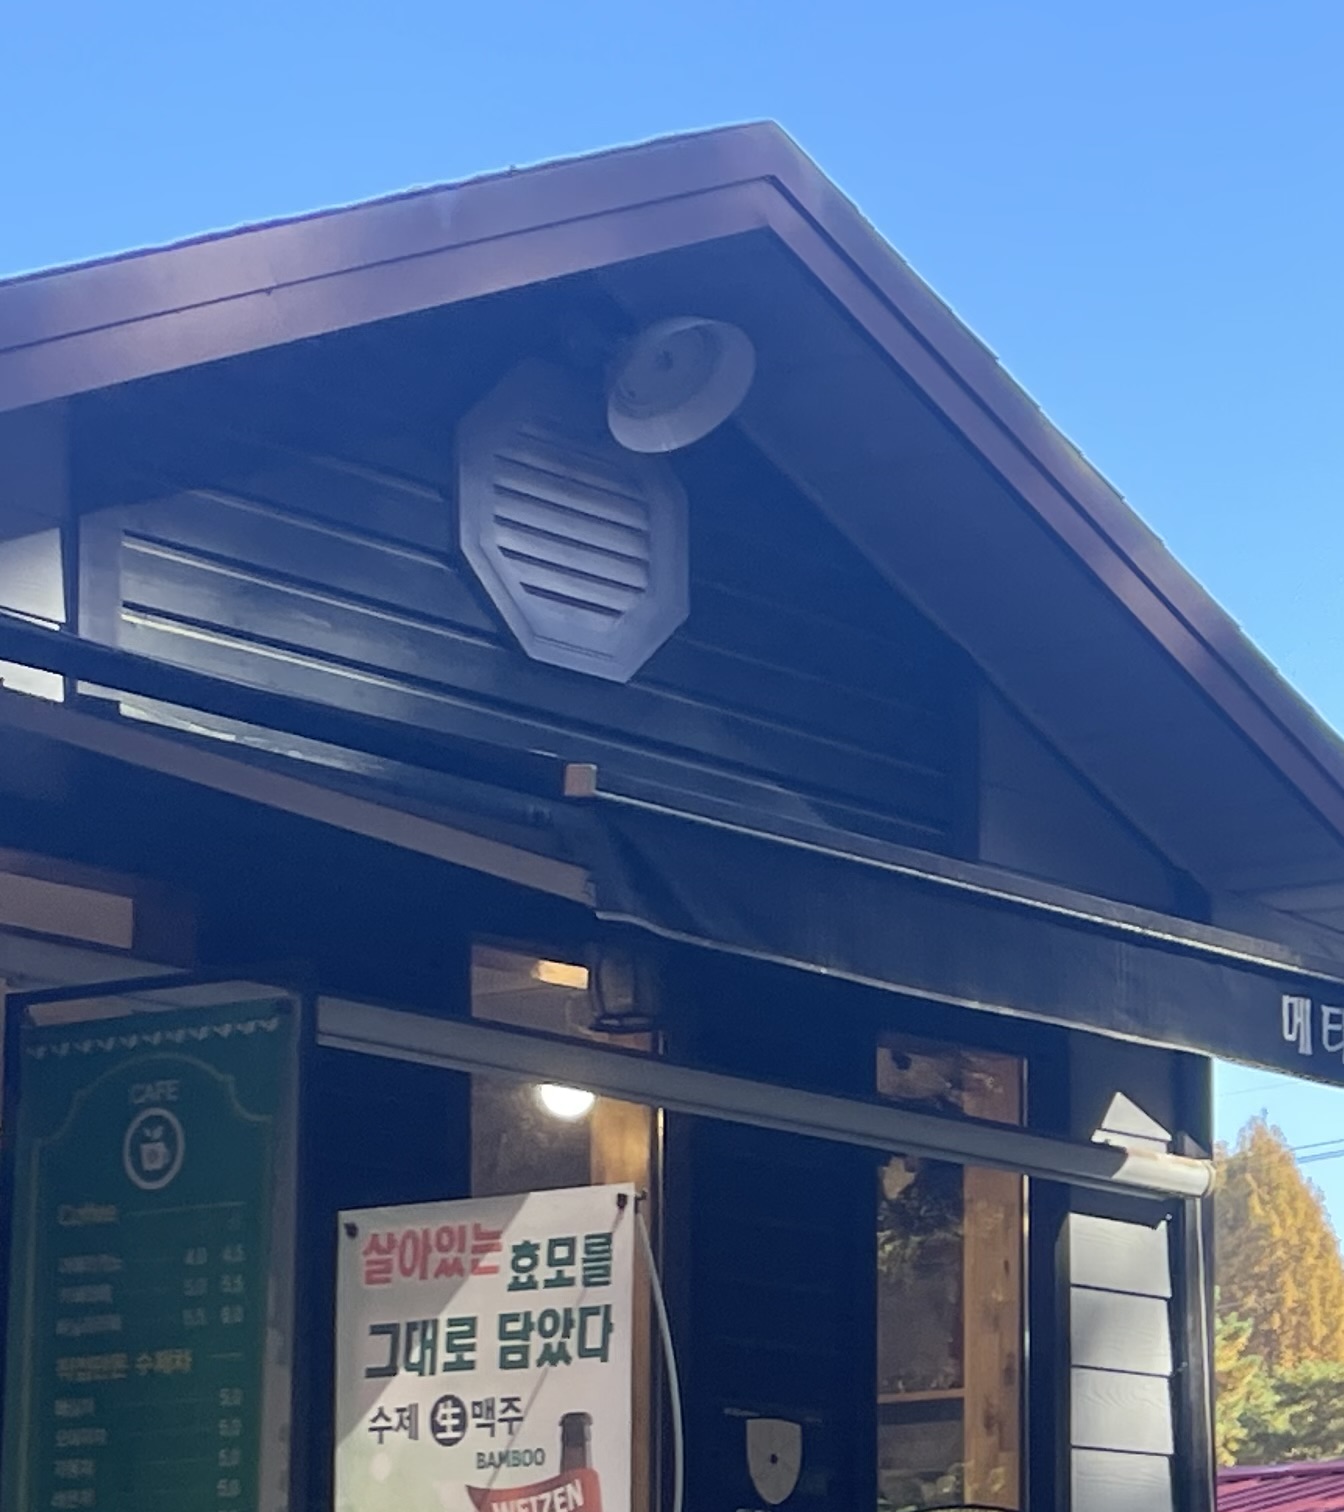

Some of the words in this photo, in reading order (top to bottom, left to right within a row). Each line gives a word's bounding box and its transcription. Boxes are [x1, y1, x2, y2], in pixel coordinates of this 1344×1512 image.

[130, 1079, 181, 1104] CAFE
[362, 1223, 503, 1285] 살아있는
[507, 1231, 613, 1291] 효모를
[364, 1316, 478, 1378] 그대로
[498, 1304, 614, 1370] 담았다
[368, 1402, 419, 1444] 수제
[476, 1448, 545, 1470] BAMBOO
